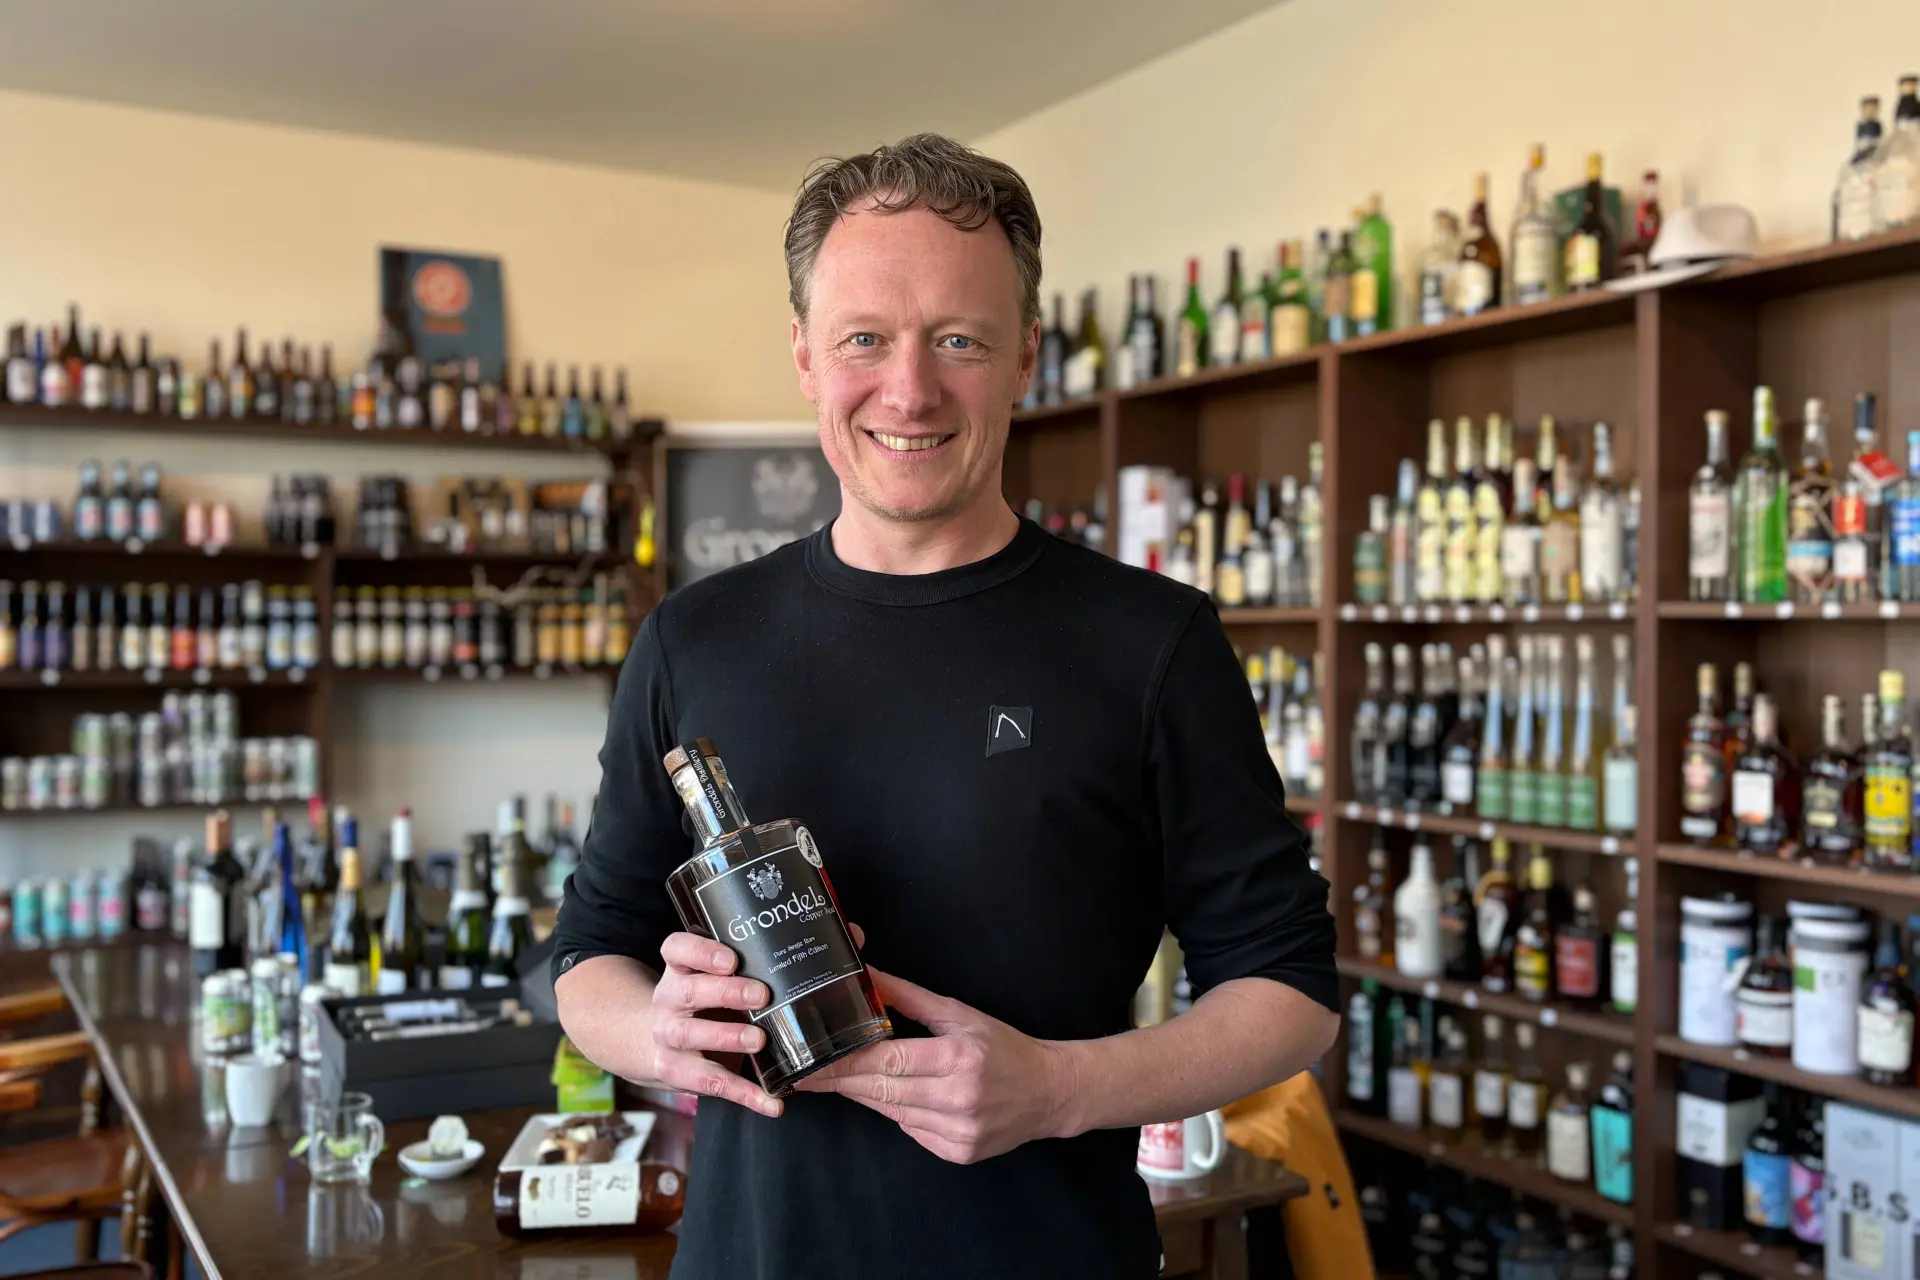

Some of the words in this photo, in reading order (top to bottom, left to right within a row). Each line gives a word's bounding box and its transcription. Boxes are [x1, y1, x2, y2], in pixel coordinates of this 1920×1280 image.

[688, 749, 709, 783] Distillery
[799, 909, 824, 923] Copper
[768, 957, 792, 974] Limited
[792, 951, 808, 963] Fifth
[807, 942, 829, 957] Edition
